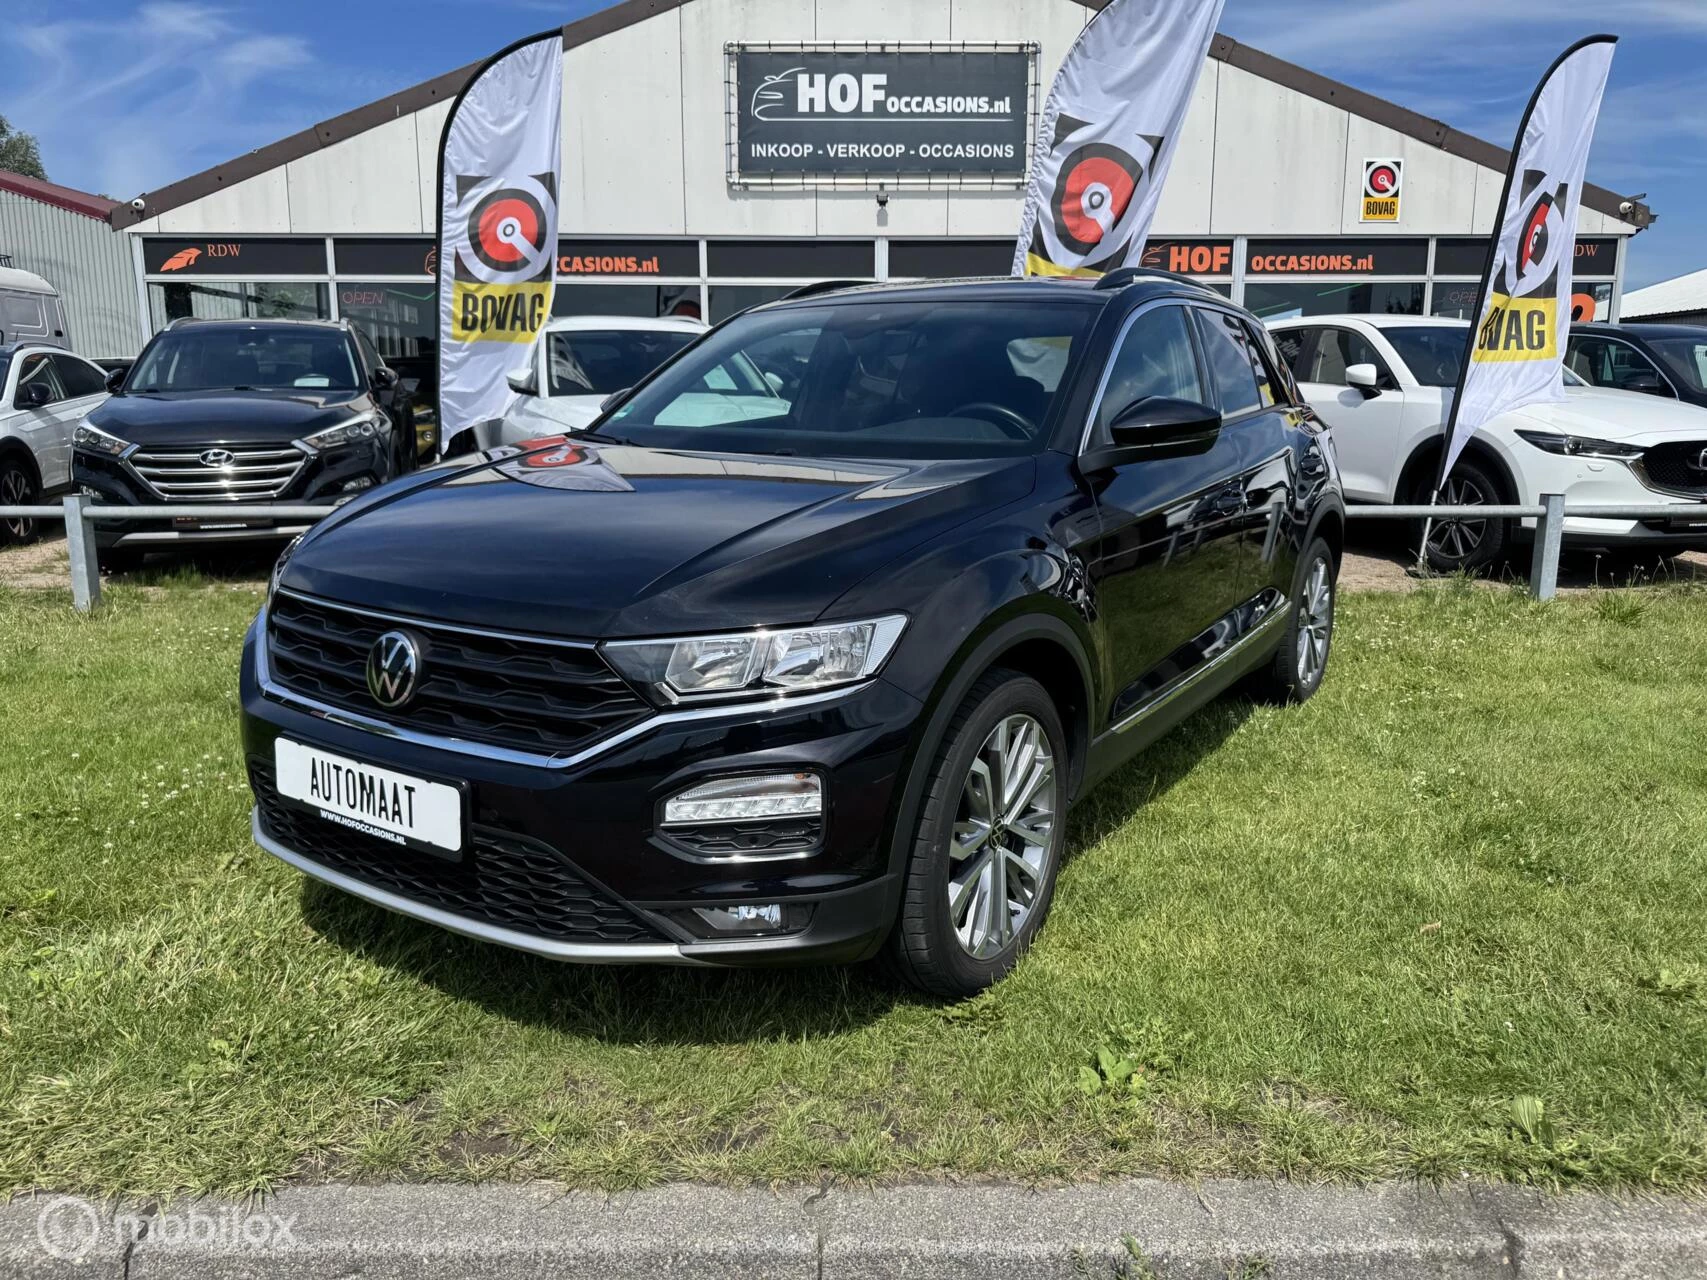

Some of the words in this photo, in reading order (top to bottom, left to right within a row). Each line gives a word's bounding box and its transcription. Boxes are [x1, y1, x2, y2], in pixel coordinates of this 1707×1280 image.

[751, 143, 813, 158] INKOOP
[827, 144, 905, 158] VERKOOP
[919, 144, 1014, 158] OCCASIONS
[1365, 200, 1396, 216] BOVAG
[207, 244, 241, 257] RDW
[1574, 244, 1598, 257] DW
[556, 256, 659, 273] CASIONS.nl
[1169, 246, 1231, 272] HOF
[1251, 255, 1373, 271] OCCASIONS.nl
[342, 291, 384, 304] OPEN
[461, 292, 545, 333] BOVAG
[311, 757, 415, 828] AUTOMAAT
[320, 809, 406, 845] WWW.HOFOCCASIONS.NL
